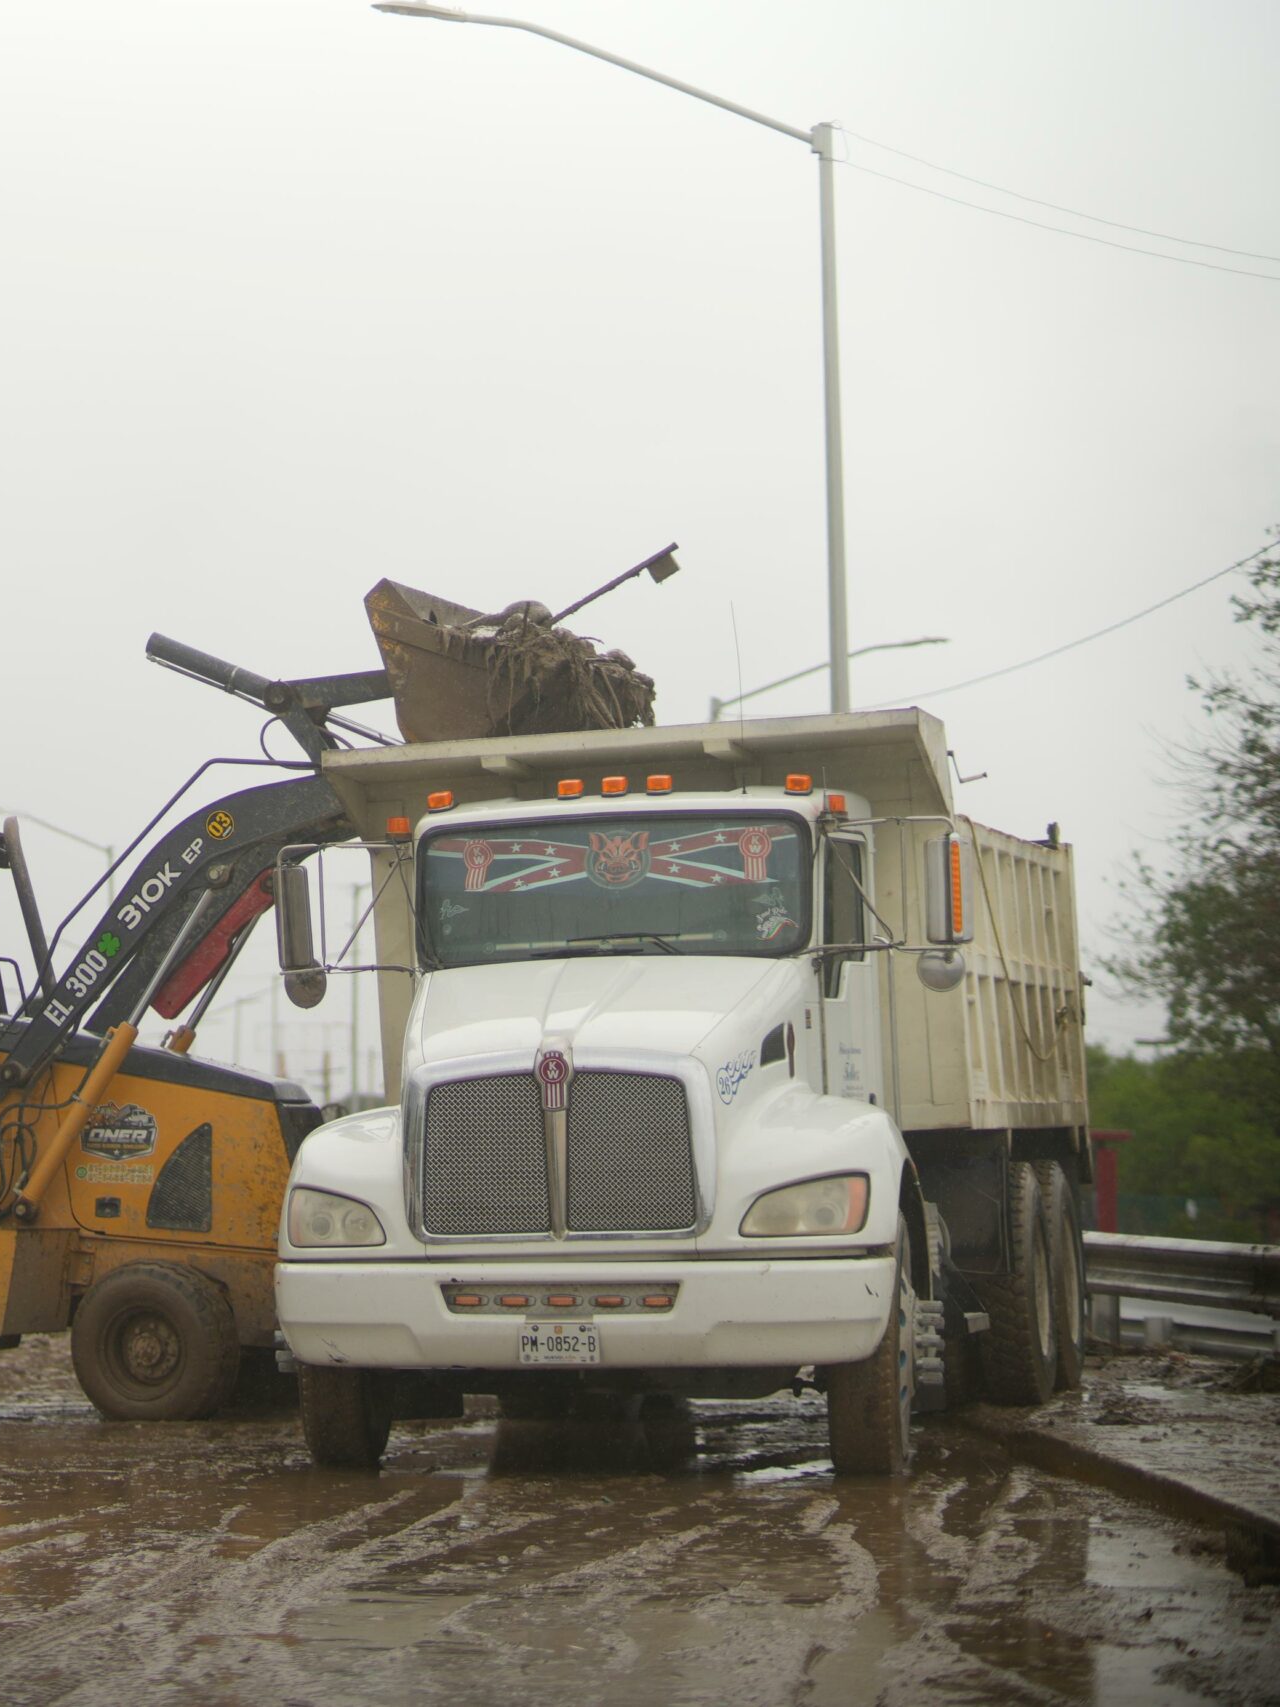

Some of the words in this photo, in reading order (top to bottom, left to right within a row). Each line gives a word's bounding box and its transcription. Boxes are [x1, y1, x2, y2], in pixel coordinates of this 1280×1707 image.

[208, 813, 230, 837] 03
[43, 999, 75, 1027] EL
[65, 949, 107, 998] 300
[117, 861, 182, 930] 310K
[181, 837, 204, 865] EP
[88, 1128, 148, 1143] ONER
[521, 1335, 596, 1352] PM-0852-B
